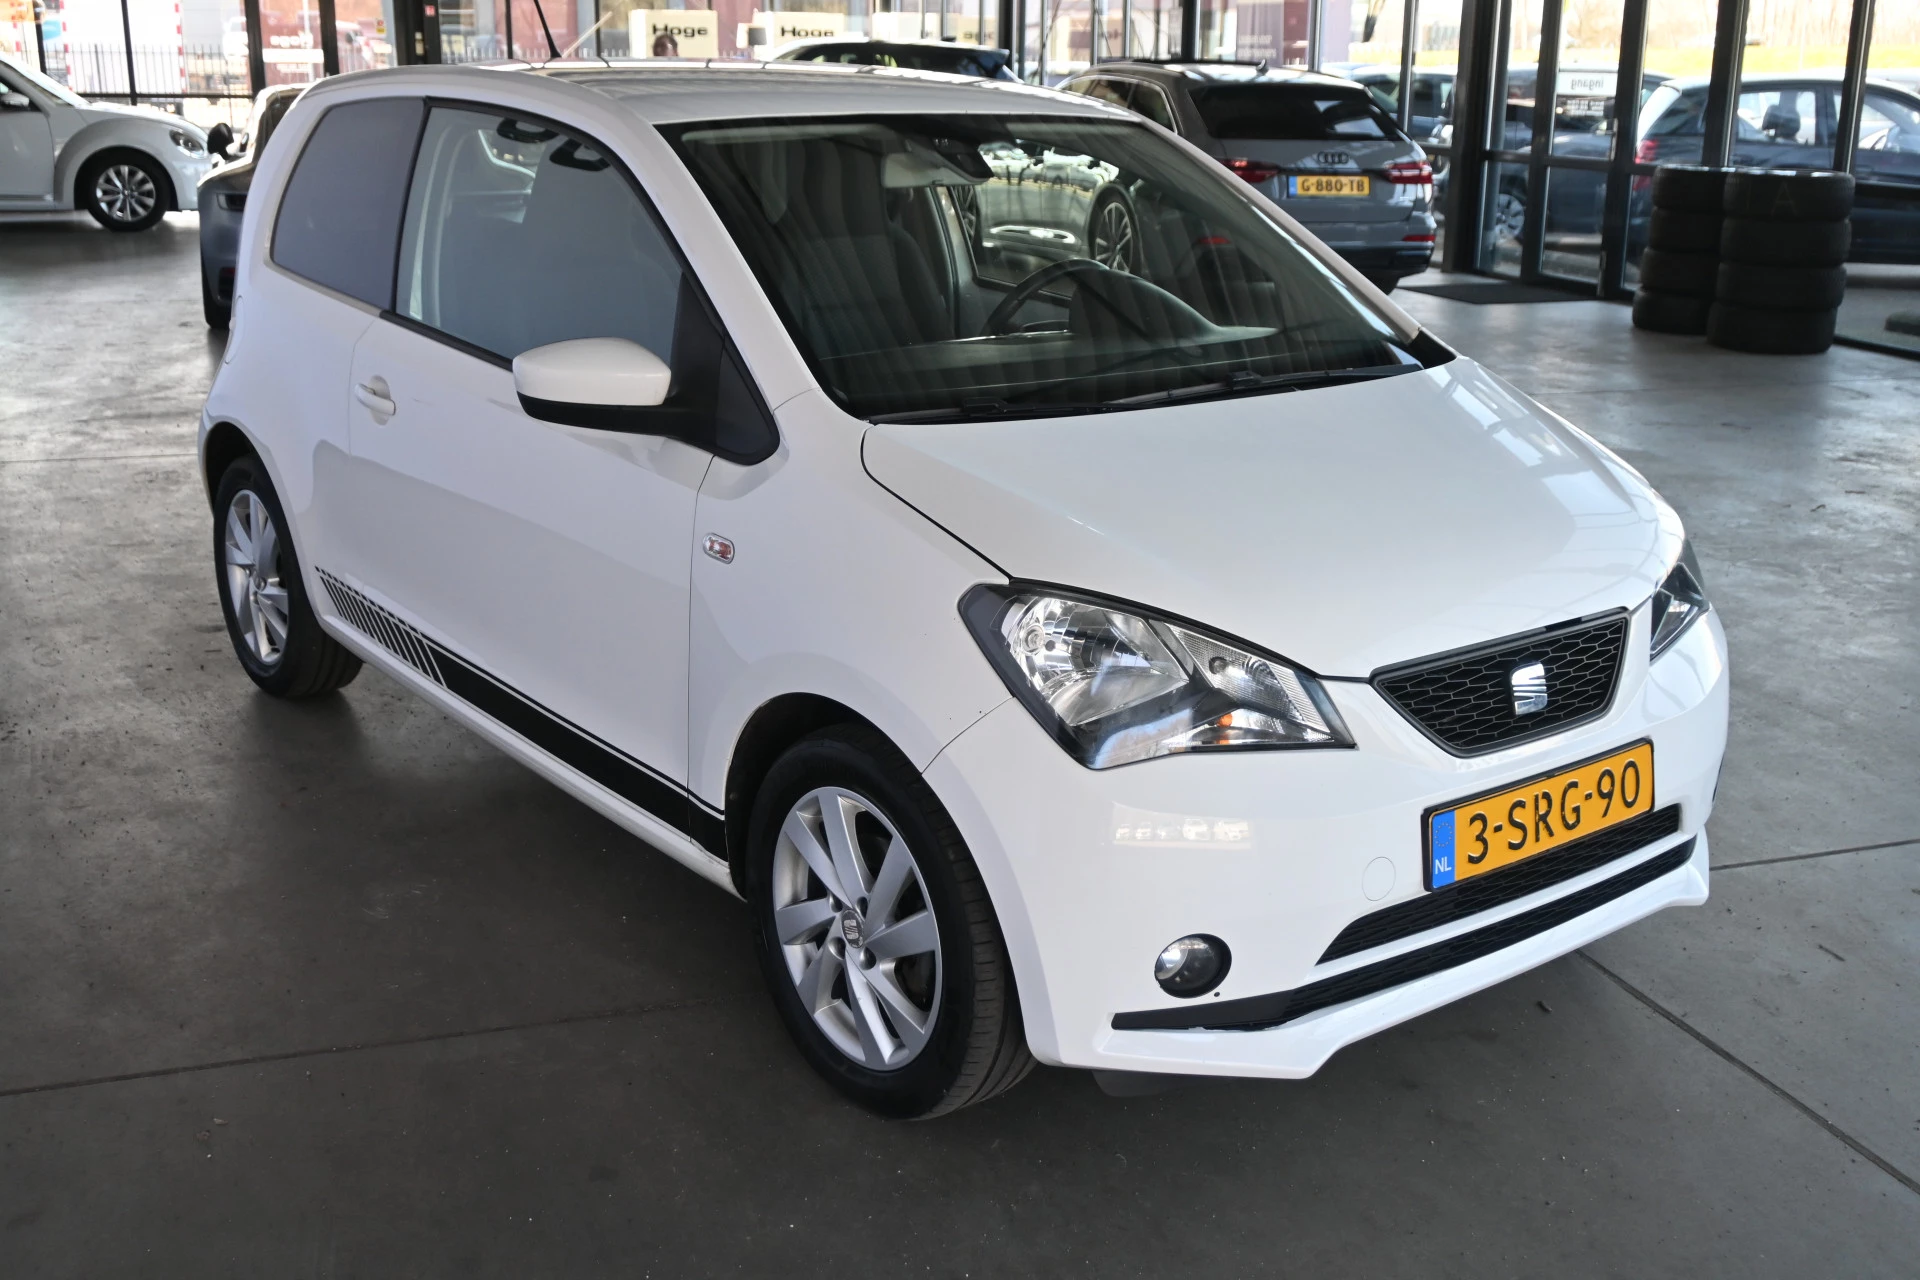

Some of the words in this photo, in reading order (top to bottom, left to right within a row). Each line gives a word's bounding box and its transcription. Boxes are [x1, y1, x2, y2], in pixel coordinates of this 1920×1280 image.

[652, 23, 707, 38] Hoge
[1301, 178, 1365, 192] G-880-TB
[1467, 758, 1641, 865] 3-SRG-90
[1434, 856, 1452, 875] NL
